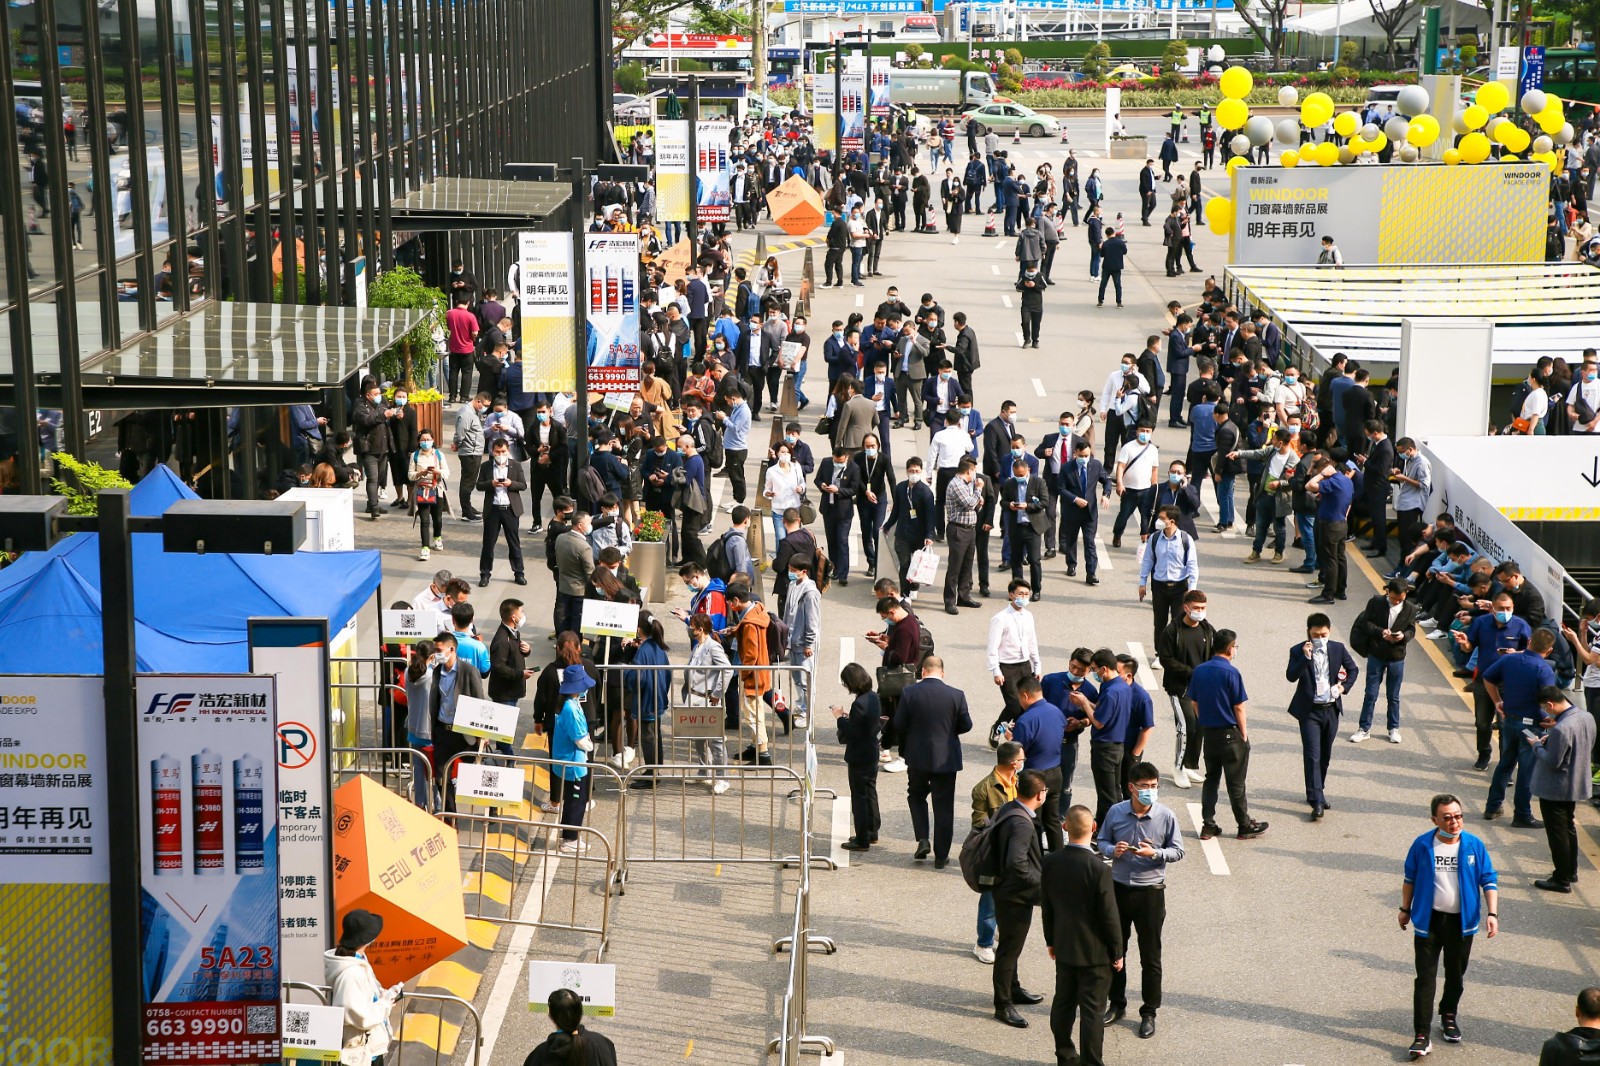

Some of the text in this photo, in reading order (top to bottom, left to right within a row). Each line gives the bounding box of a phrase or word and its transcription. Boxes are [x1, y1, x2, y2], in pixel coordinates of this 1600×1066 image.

[1249, 187, 1329, 201] WINDOOR
[1248, 203, 1328, 215] 门窗幕墙新品展
[1247, 221, 1316, 238] 明年再见
[526, 284, 569, 295] 明年再见
[588, 373, 626, 381] 663 9990
[88, 410, 102, 437] E2
[0, 695, 37, 705] DOOR
[198, 693, 268, 708] 浩宏新材
[15, 707, 38, 715] EXPO
[679, 715, 718, 724] PWTC
[0, 753, 88, 769] INDOOR
[280, 790, 307, 803] 临时
[280, 805, 321, 819] 下客点
[16, 836, 92, 844] 保利世贸博览馆
[281, 834, 323, 842] and down
[199, 946, 274, 970] 5A23
[175, 1008, 209, 1017] CONTACT
[210, 1008, 243, 1016] NUMBER
[146, 1018, 243, 1036] 663 9990
